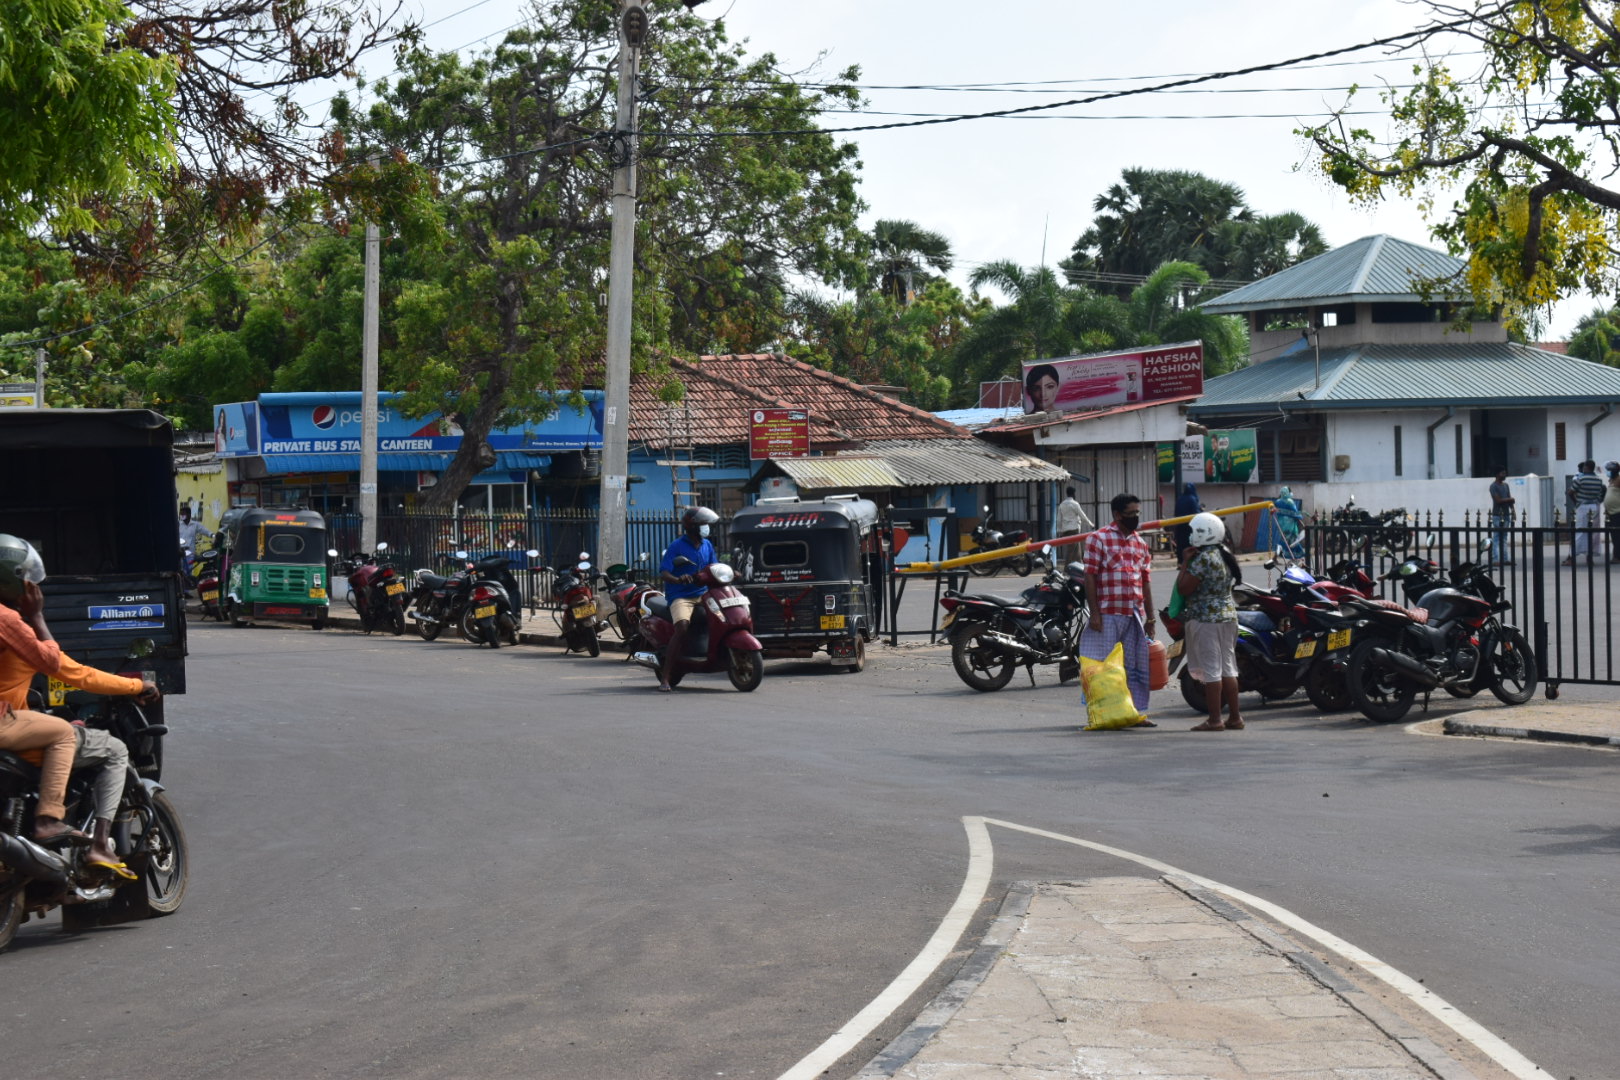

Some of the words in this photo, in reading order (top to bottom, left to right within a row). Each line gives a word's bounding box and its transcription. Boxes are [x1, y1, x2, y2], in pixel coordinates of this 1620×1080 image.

[1145, 351, 1198, 365] HAFSHA
[1143, 361, 1201, 376] FASHION
[340, 407, 392, 427] pesi
[264, 441, 311, 452] PRIVATE
[314, 440, 337, 451] BUS
[339, 440, 361, 451] STA
[380, 439, 433, 450] CANTEEN
[1183, 441, 1200, 451] HAKIB
[1182, 452, 1192, 460] OOL
[100, 609, 138, 619] Allianz
